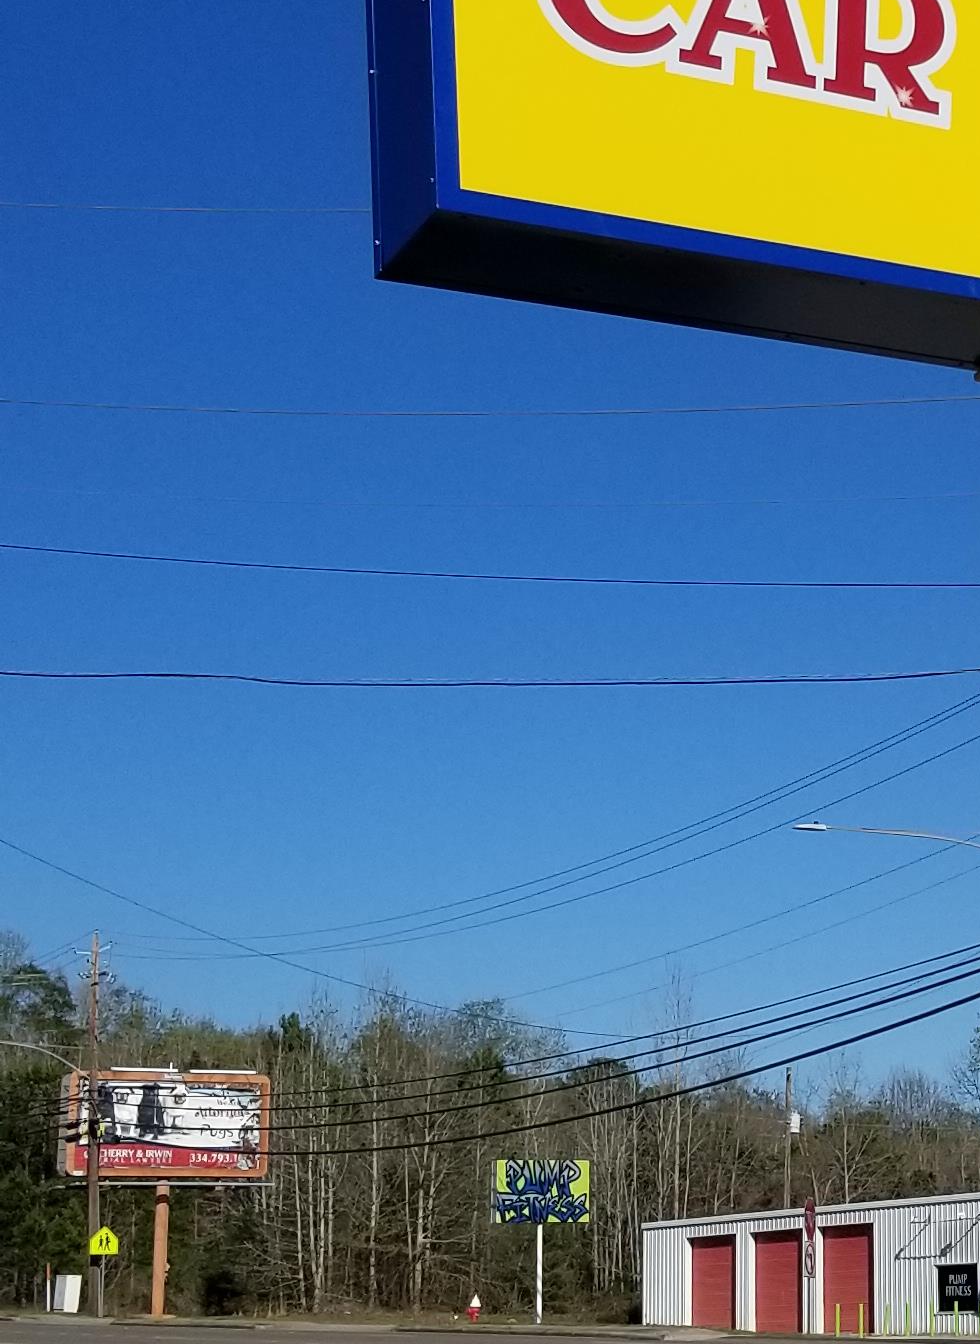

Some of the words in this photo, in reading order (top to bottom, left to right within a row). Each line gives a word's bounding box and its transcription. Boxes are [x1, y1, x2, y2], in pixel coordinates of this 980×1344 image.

[136, 1149, 143, 1158] &
[145, 1149, 173, 1159] IRWIN
[506, 1159, 581, 1197] PUMP
[496, 1192, 589, 1224] FITNESS
[949, 1273, 968, 1285] PUMP
[945, 1285, 972, 1296] FITNESS
